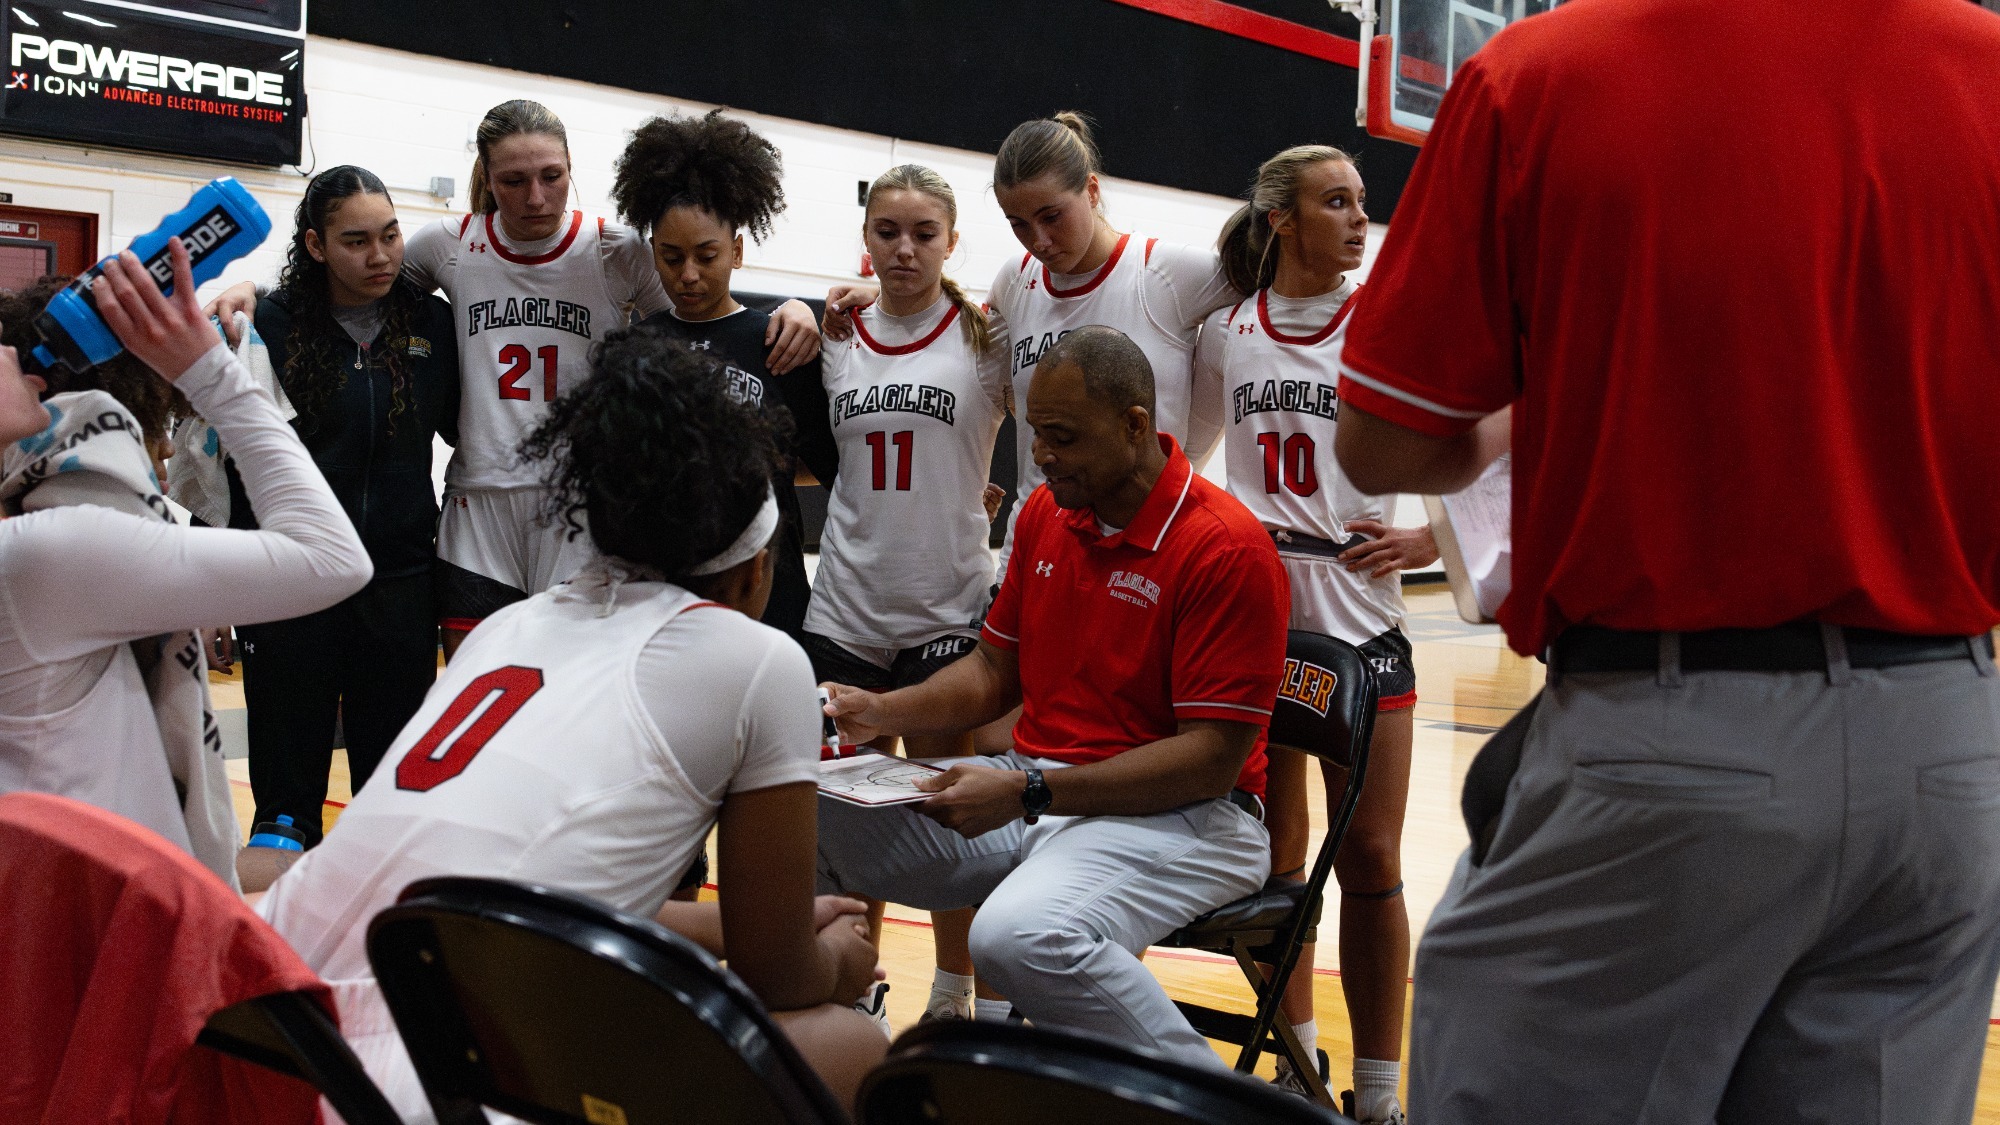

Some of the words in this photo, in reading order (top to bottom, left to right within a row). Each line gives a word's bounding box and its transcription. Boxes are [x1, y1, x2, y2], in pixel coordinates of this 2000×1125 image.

[103, 86, 163, 107] ADVANCED
[167, 95, 239, 117] ELECTROLYTE
[243, 106, 284, 123] SYSTEM
[147, 213, 234, 284] EADE
[468, 297, 592, 340] FLAGLER
[498, 343, 559, 403] 21
[1012, 330, 1071, 378] FLA
[834, 384, 957, 428] FLAGLER
[1233, 379, 1338, 425] FLAGLE
[865, 430, 914, 491] 11
[1256, 431, 1319, 497] 10
[1106, 570, 1161, 605] FLAGLER
[1109, 589, 1148, 609] BASKETBALL
[921, 637, 969, 660] PBC
[395, 664, 545, 793] 0
